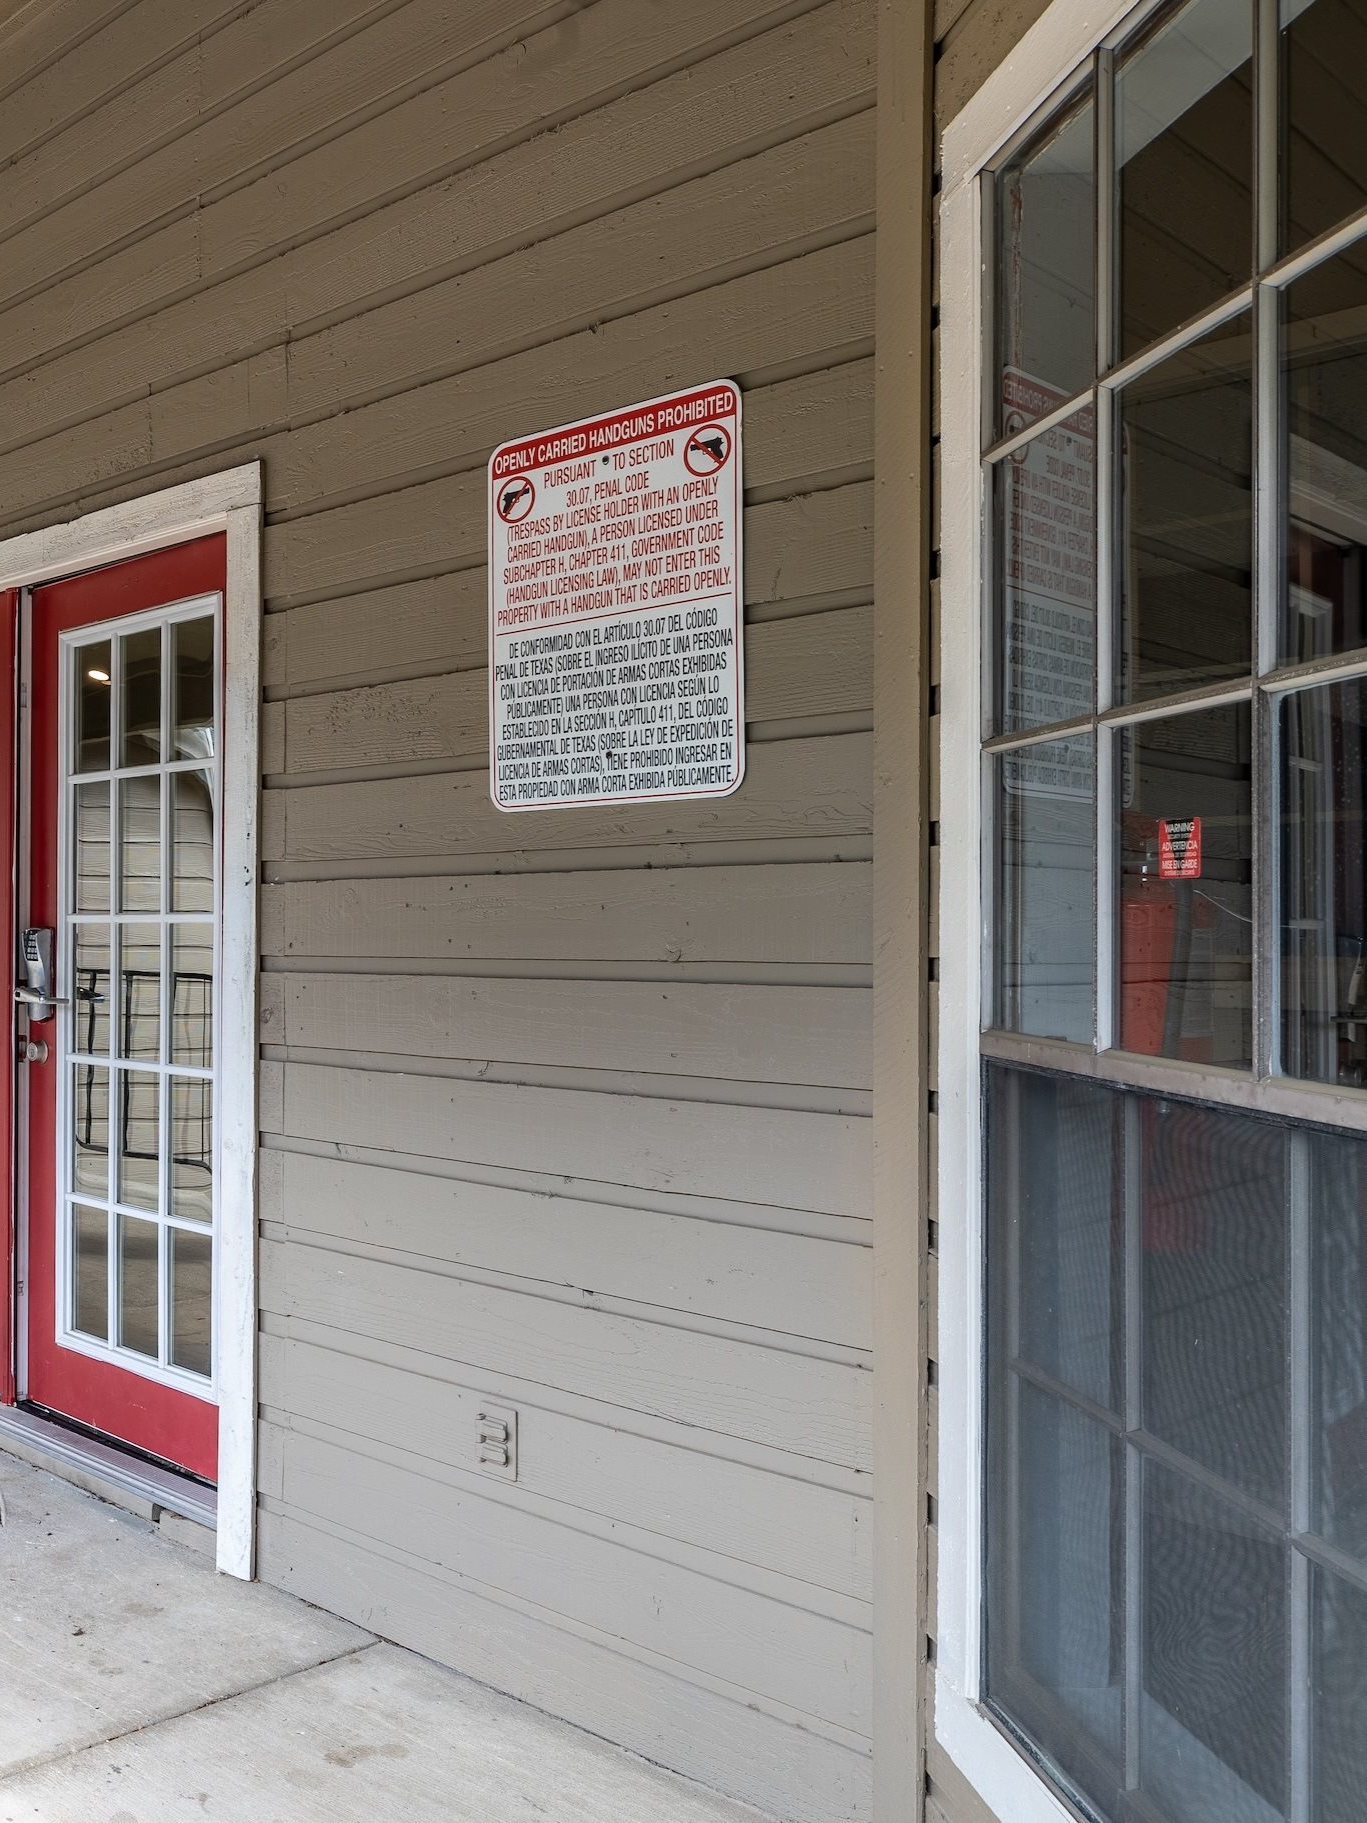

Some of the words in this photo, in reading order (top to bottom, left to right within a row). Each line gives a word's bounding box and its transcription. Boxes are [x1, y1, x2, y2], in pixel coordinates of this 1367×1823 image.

[495, 447, 535, 474] OPENLY
[538, 433, 586, 462] CARRIED
[589, 414, 654, 448] HANDGUNS
[658, 391, 733, 429] PROHIBITED
[544, 460, 596, 488] PURSUANT
[613, 451, 626, 470] TO
[629, 439, 674, 466] SECTION
[507, 517, 550, 545] (TRESPASS
[553, 514, 563, 531] BY
[566, 505, 601, 529] LICENSE
[604, 496, 639, 520] HOLDER
[641, 490, 664, 511] WITH
[667, 486, 679, 505] AN
[683, 477, 718, 501] OPENLY
[567, 486, 592, 507] 30.07,
[595, 478, 622, 500] PENAL
[625, 471, 649, 493] CODE
[504, 558, 556, 584] SUBCHAPTER
[559, 556, 566, 575] H,
[569, 547, 607, 570] CHAPTER
[611, 542, 629, 561] 411,
[632, 528, 693, 557] GOVERNMENT
[698, 522, 723, 543] CODE
[508, 540, 542, 563] CARRIED
[544, 529, 590, 555] HANDGUN),
[592, 528, 598, 544] A
[600, 519, 635, 542] PERSON
[639, 508, 684, 534] LICENSED
[685, 500, 718, 523] UNDER
[498, 604, 538, 626] PROPERTY
[540, 599, 561, 619] WITH
[563, 598, 569, 615] A
[571, 589, 613, 613] HANDGUN
[615, 585, 637, 605] THAT
[640, 583, 648, 600] IS
[651, 575, 691, 598] CARRIED
[694, 567, 731, 590] OPENLY.
[507, 581, 548, 607] (HANDGUN
[551, 571, 594, 596] LICENSING
[597, 566, 621, 587] LAW),
[623, 562, 643, 581] MAY
[645, 557, 663, 577] NOT
[666, 551, 696, 573] ENTER
[699, 546, 720, 566] THIS
[496, 663, 518, 681] PENAL
[520, 661, 529, 677] DE
[531, 657, 553, 675] TEXAS
[555, 652, 582, 675] (SOBRE
[584, 651, 594, 667] EL
[595, 645, 629, 666] INGRESO
[660, 638, 671, 656] DE
[673, 635, 691, 654] UNA
[693, 629, 733, 651] PERSONA
[509, 642, 519, 659] DE
[521, 633, 573, 657] CONFORMIDAD
[575, 630, 591, 648] CON
[593, 628, 602, 645] EL
[604, 621, 641, 643] ARTÍCULO
[644, 617, 665, 637] 30.07
[668, 614, 683, 632] DEL
[686, 608, 717, 629] CÓDIGO
[501, 683, 515, 700] CON
[517, 678, 549, 698] LICENCIA
[551, 677, 560, 693] DE
[563, 668, 604, 691] PORTACIÓN
[606, 668, 616, 685] DE
[618, 664, 646, 684] ARMAS
[649, 659, 680, 679] CORTAS
[683, 653, 726, 674] EXHIBIDAS
[507, 697, 563, 719] PÚBLICAMENTE)
[565, 695, 581, 712] UNA
[583, 689, 619, 710] PERSONA
[621, 687, 637, 705] CON
[639, 681, 676, 702] LICENCIA
[678, 675, 706, 697] SEGÚN
[708, 676, 719, 693] LO
[497, 739, 559, 760] GUBERNAMENTAL
[561, 738, 570, 754] DE
[572, 735, 596, 753] TEXAS
[598, 731, 626, 753] (SOBRE
[628, 730, 638, 747] LA
[640, 728, 654, 746] LEY
[657, 727, 668, 744] DE
[670, 718, 719, 742] EXPEDICIÓN
[722, 719, 733, 737] DE
[502, 719, 550, 740] ESTABLECIDO
[551, 718, 561, 734] EN
[563, 716, 572, 733] LA
[575, 709, 607, 732] SECCIÓN
[609, 711, 617, 730] H,
[619, 705, 657, 726] CAPÍTULO
[659, 704, 676, 723] 411,
[678, 701, 695, 719] DEL
[696, 696, 728, 717] CÓDIGO
[498, 784, 517, 800] ESTA
[518, 781, 559, 799] PROPIEDAD
[560, 779, 576, 795] CON
[578, 777, 600, 794] ARMA
[602, 774, 627, 792] CORTA
[629, 771, 666, 790] EXHIBIDA
[668, 765, 734, 787] PÚBLICAMENTE.
[499, 763, 530, 780] LICENCIA
[532, 762, 541, 777] DE
[543, 759, 569, 776] ARMAS
[571, 755, 605, 774] CORTAS),
[606, 753, 628, 770] TIENE
[630, 748, 673, 768] PROHIBIDO
[676, 744, 717, 764] INGRESAR
[720, 743, 732, 760] EN
[1162, 840, 1198, 851] ADVERTENCIA
[1164, 822, 1195, 833] WARNING
[1180, 859, 1198, 869] GARDE
